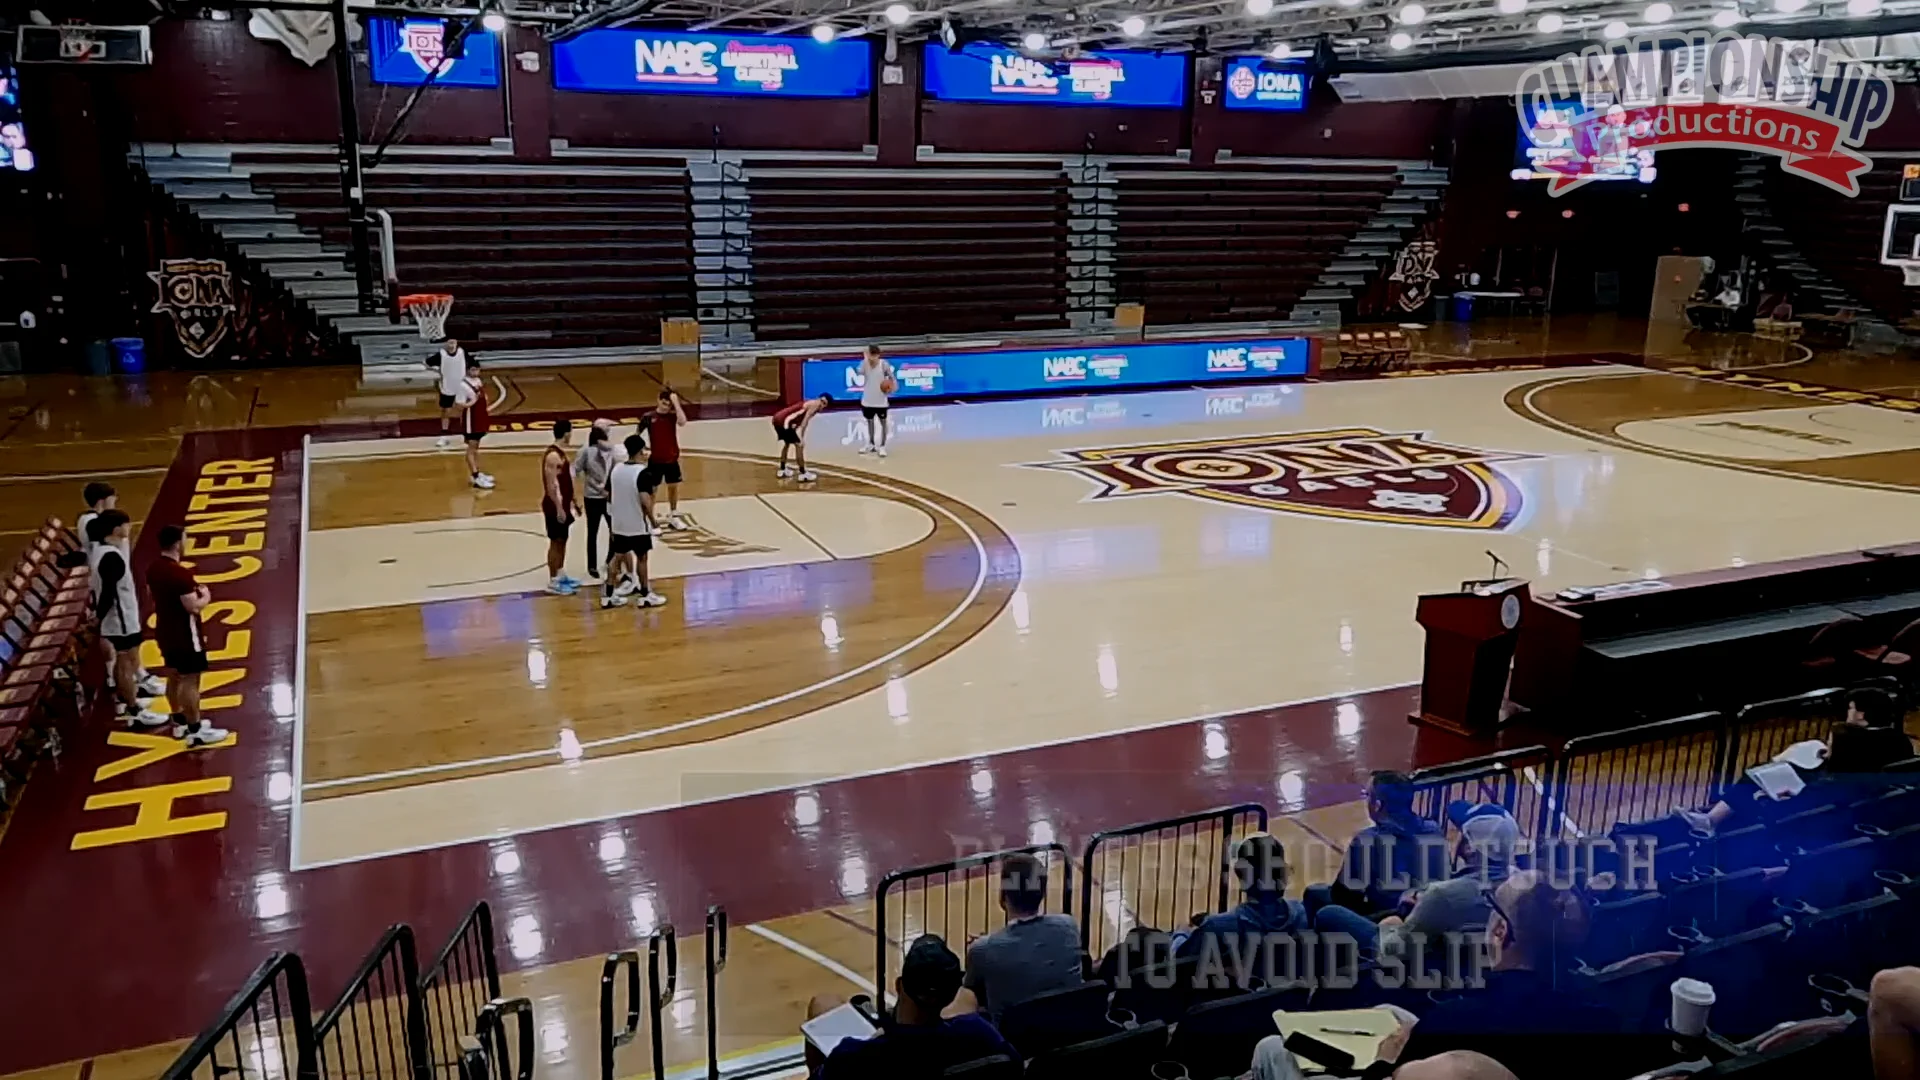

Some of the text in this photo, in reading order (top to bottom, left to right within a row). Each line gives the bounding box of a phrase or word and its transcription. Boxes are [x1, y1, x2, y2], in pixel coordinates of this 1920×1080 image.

[634, 39, 718, 76] NABC
[1257, 71, 1301, 92] IONA
[1043, 356, 1087, 377] NABC
[180, 456, 276, 586] CENTER
